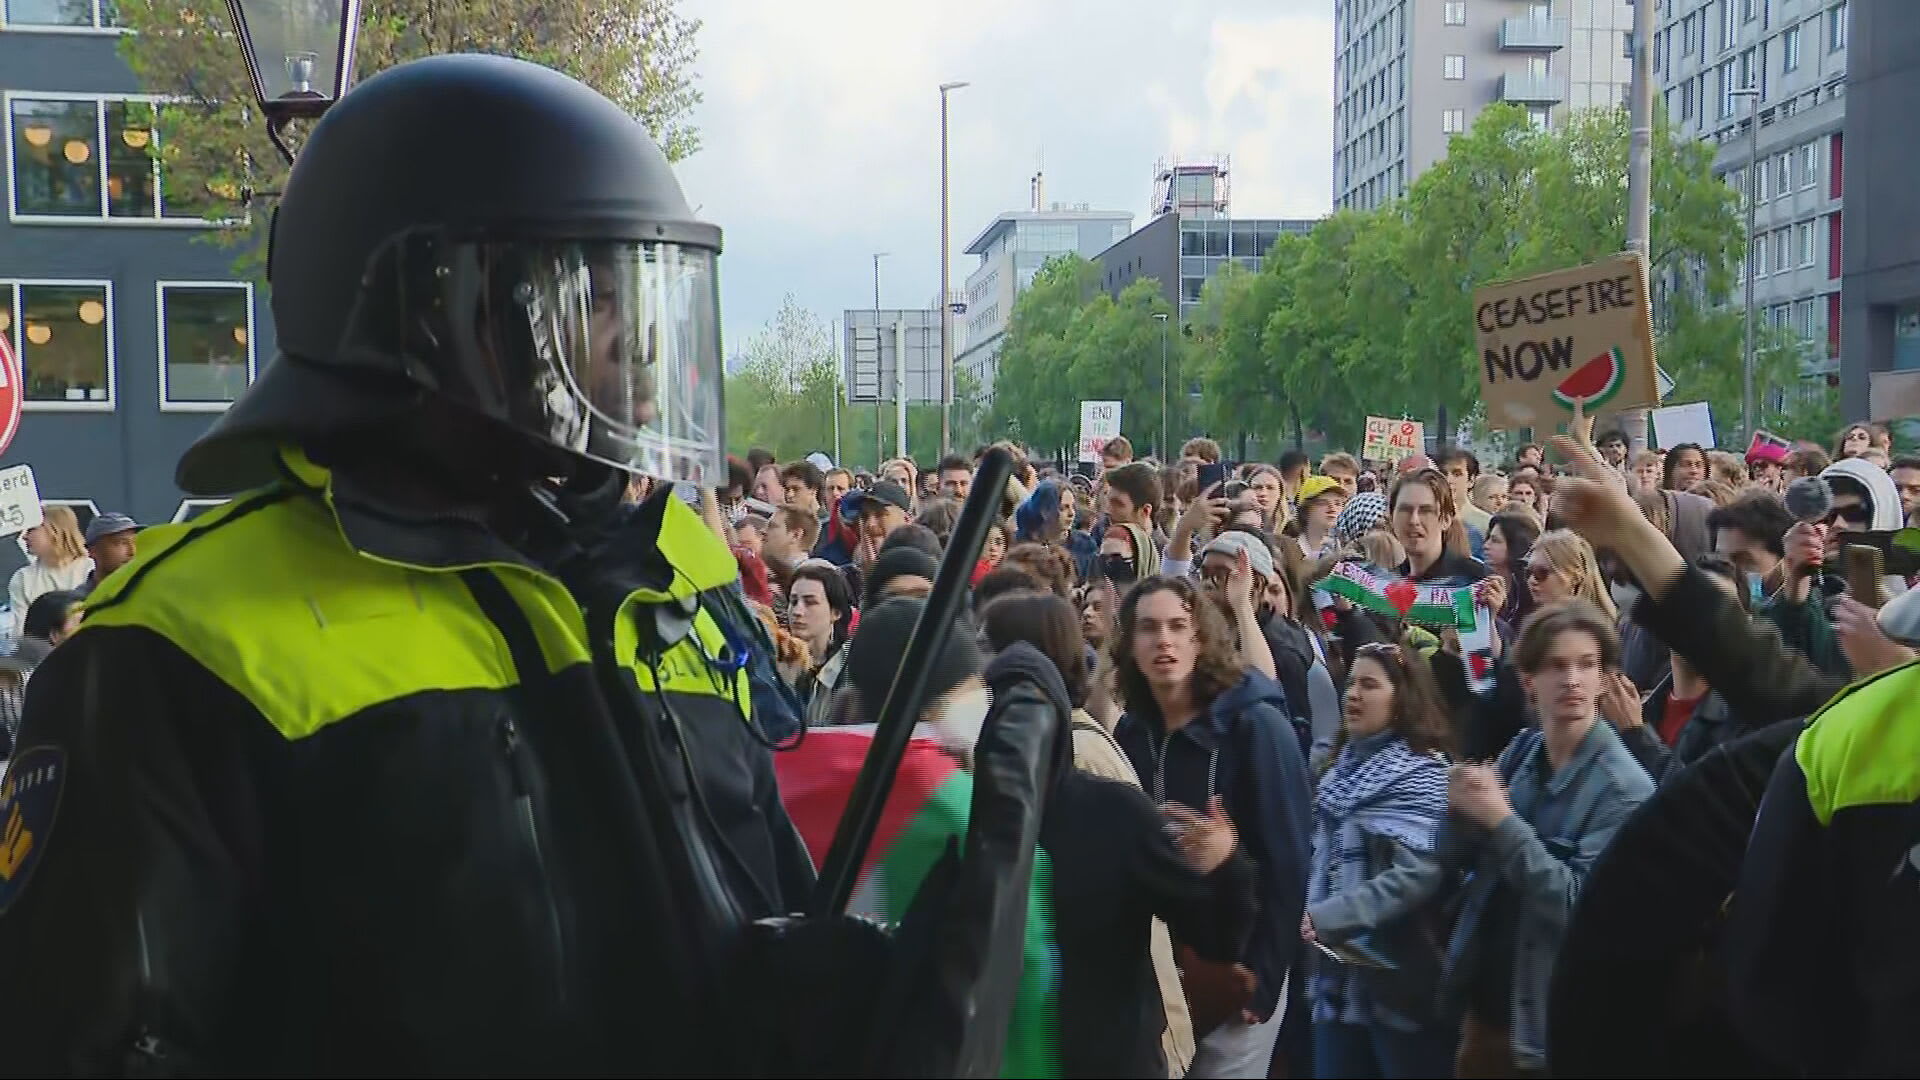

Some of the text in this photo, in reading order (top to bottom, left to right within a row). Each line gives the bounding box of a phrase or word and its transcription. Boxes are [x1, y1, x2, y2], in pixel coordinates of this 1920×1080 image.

[1476, 274, 1634, 334] CEASEFIRE
[1483, 336, 1574, 384] NOW
[1092, 406, 1112, 420] END
[1369, 421, 1395, 435] CUT
[1390, 434, 1415, 448] ALL
[0, 469, 29, 493] erd
